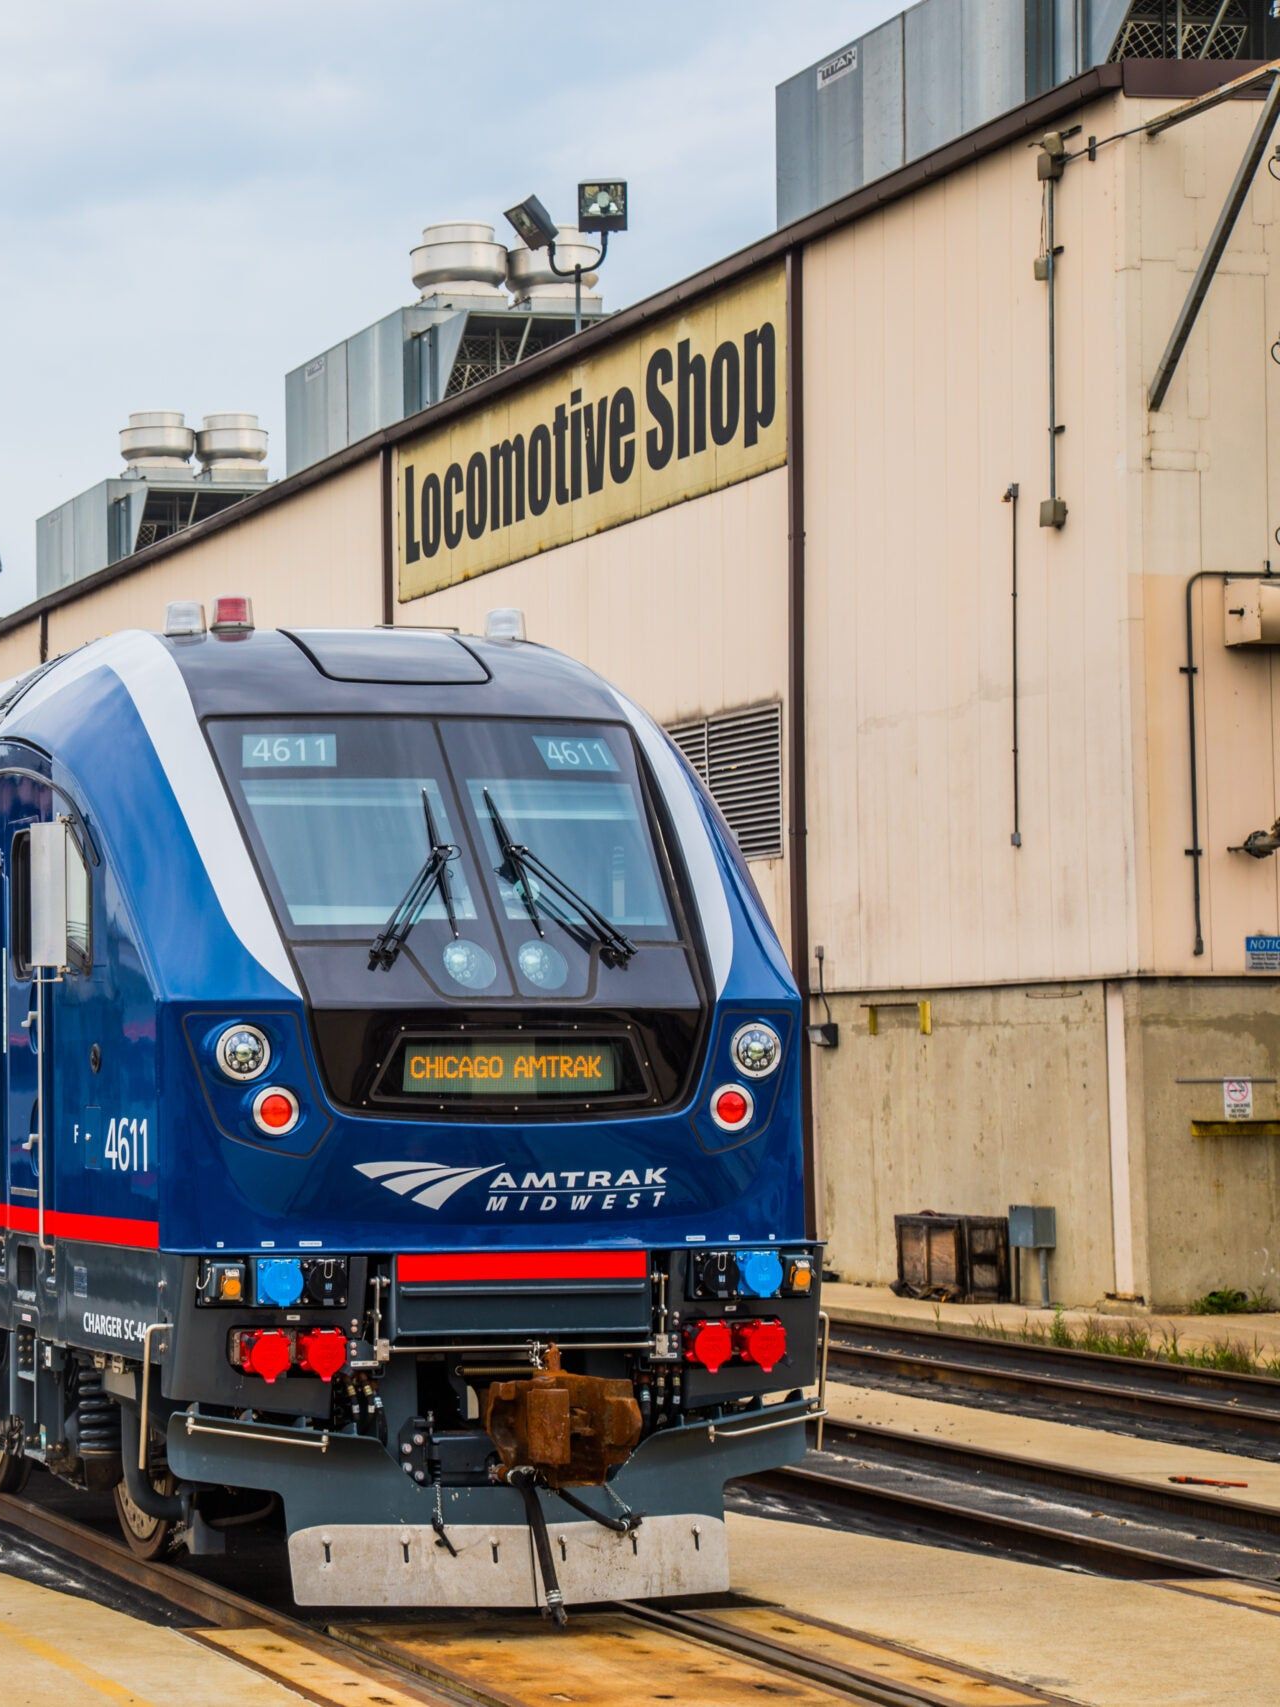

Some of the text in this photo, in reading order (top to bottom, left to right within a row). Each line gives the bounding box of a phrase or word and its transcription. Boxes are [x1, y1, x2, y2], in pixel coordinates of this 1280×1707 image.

[818, 49, 857, 80] TITAN
[404, 321, 776, 565] Locomotive Shop
[252, 738, 327, 762] 4611
[546, 740, 610, 766] 4611
[410, 1055, 603, 1079] CHICAGO AMTRAK
[73, 1124, 80, 1144] F
[104, 1117, 148, 1172] 4611
[489, 1167, 668, 1189] AMTRAK
[486, 1191, 666, 1212] MIDWEST
[83, 1312, 147, 1342] CHARGER SC-44
